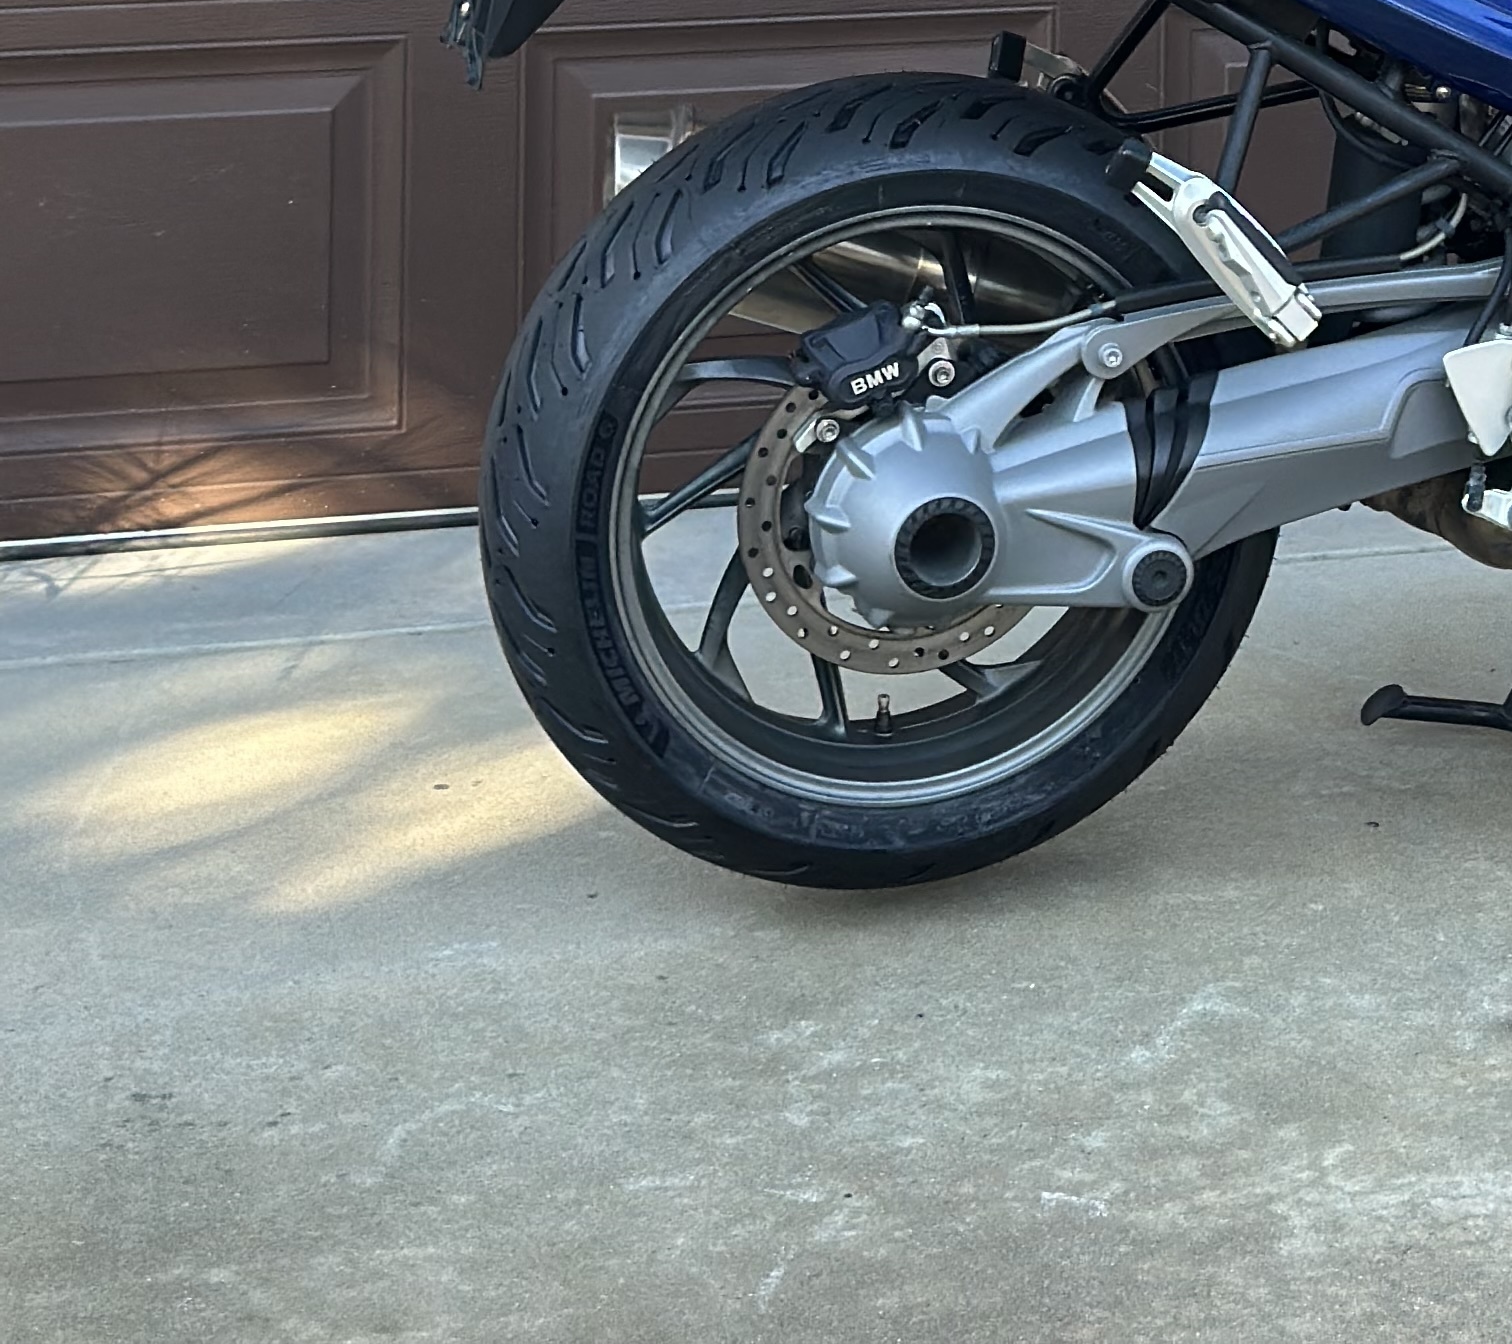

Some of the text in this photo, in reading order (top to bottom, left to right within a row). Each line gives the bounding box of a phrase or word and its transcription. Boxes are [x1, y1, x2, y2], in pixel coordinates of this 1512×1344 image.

[850, 362, 899, 395] BMW
[579, 447, 605, 529] ROAD
[578, 555, 641, 706] MICHELIN
